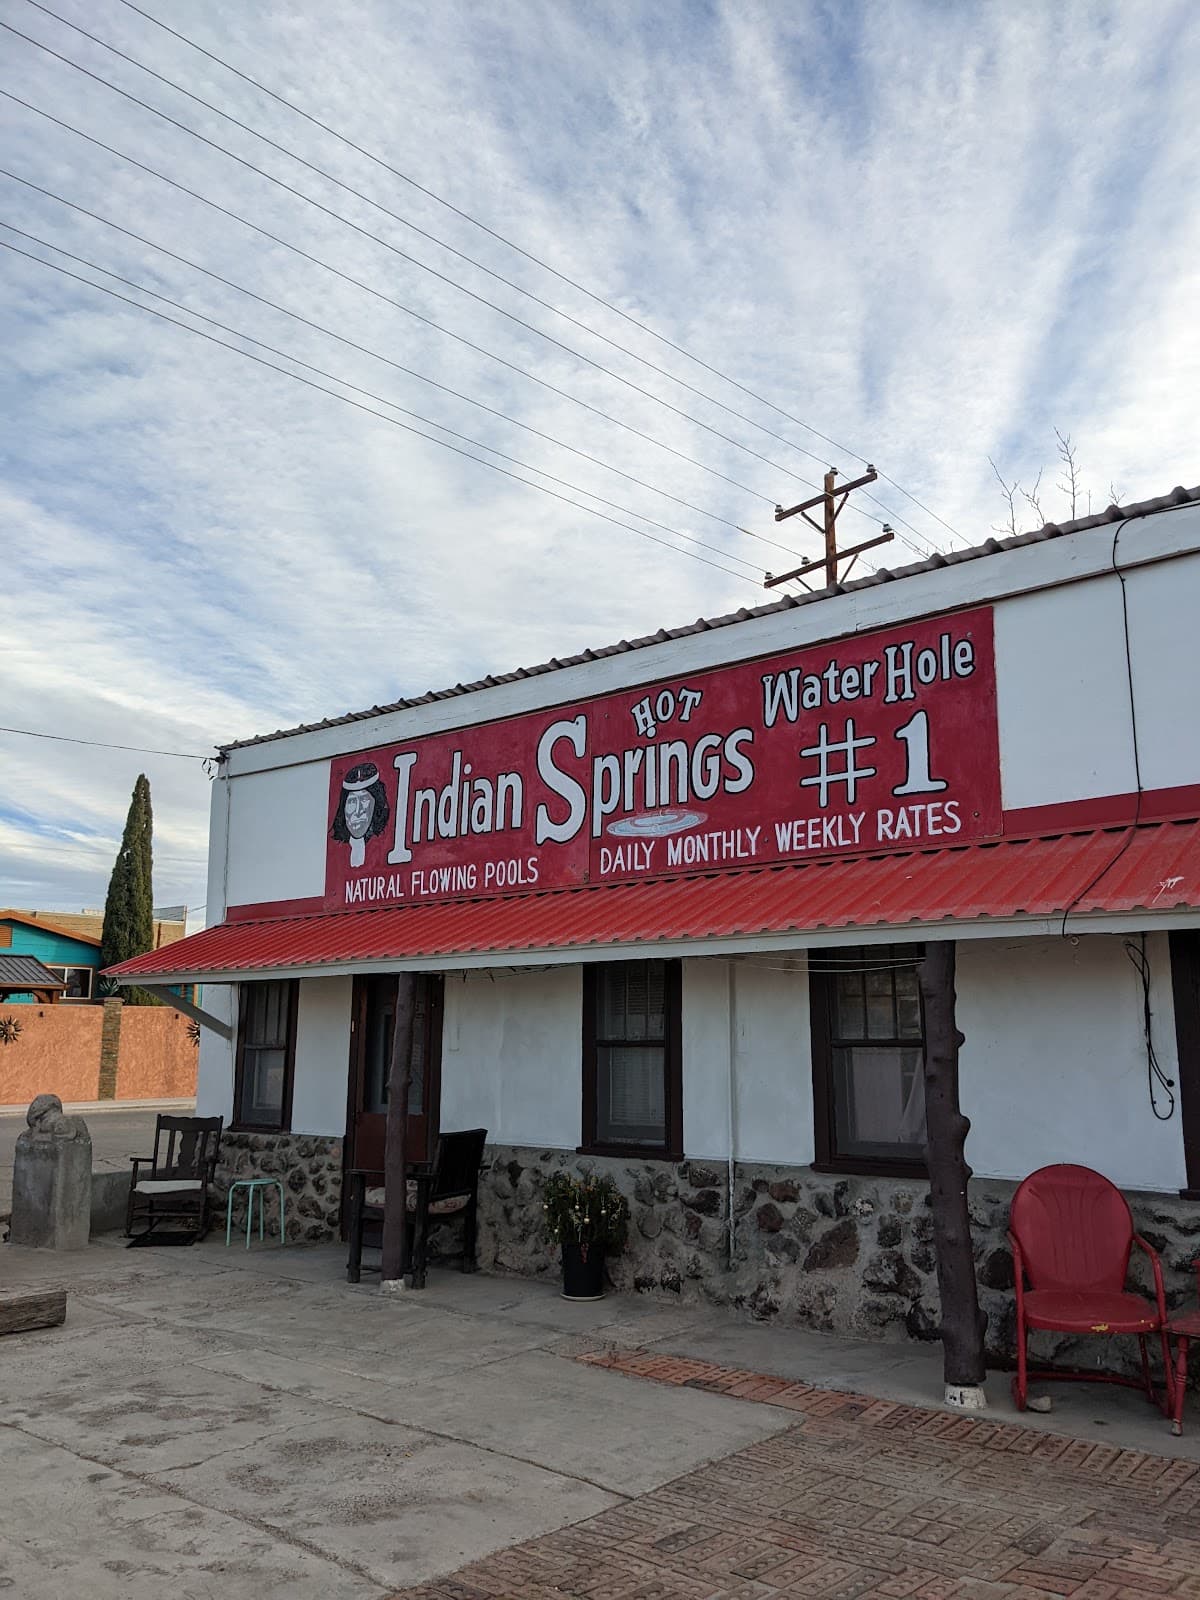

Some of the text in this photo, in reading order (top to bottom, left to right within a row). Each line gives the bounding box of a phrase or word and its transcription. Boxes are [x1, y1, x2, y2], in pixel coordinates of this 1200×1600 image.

[631, 688, 702, 736] HOT
[387, 751, 523, 865] Indian
[600, 800, 962, 874] DAILY MONTHLY WEEKLY RATES
[345, 856, 539, 904] NATURAL FLOWING POOLS
